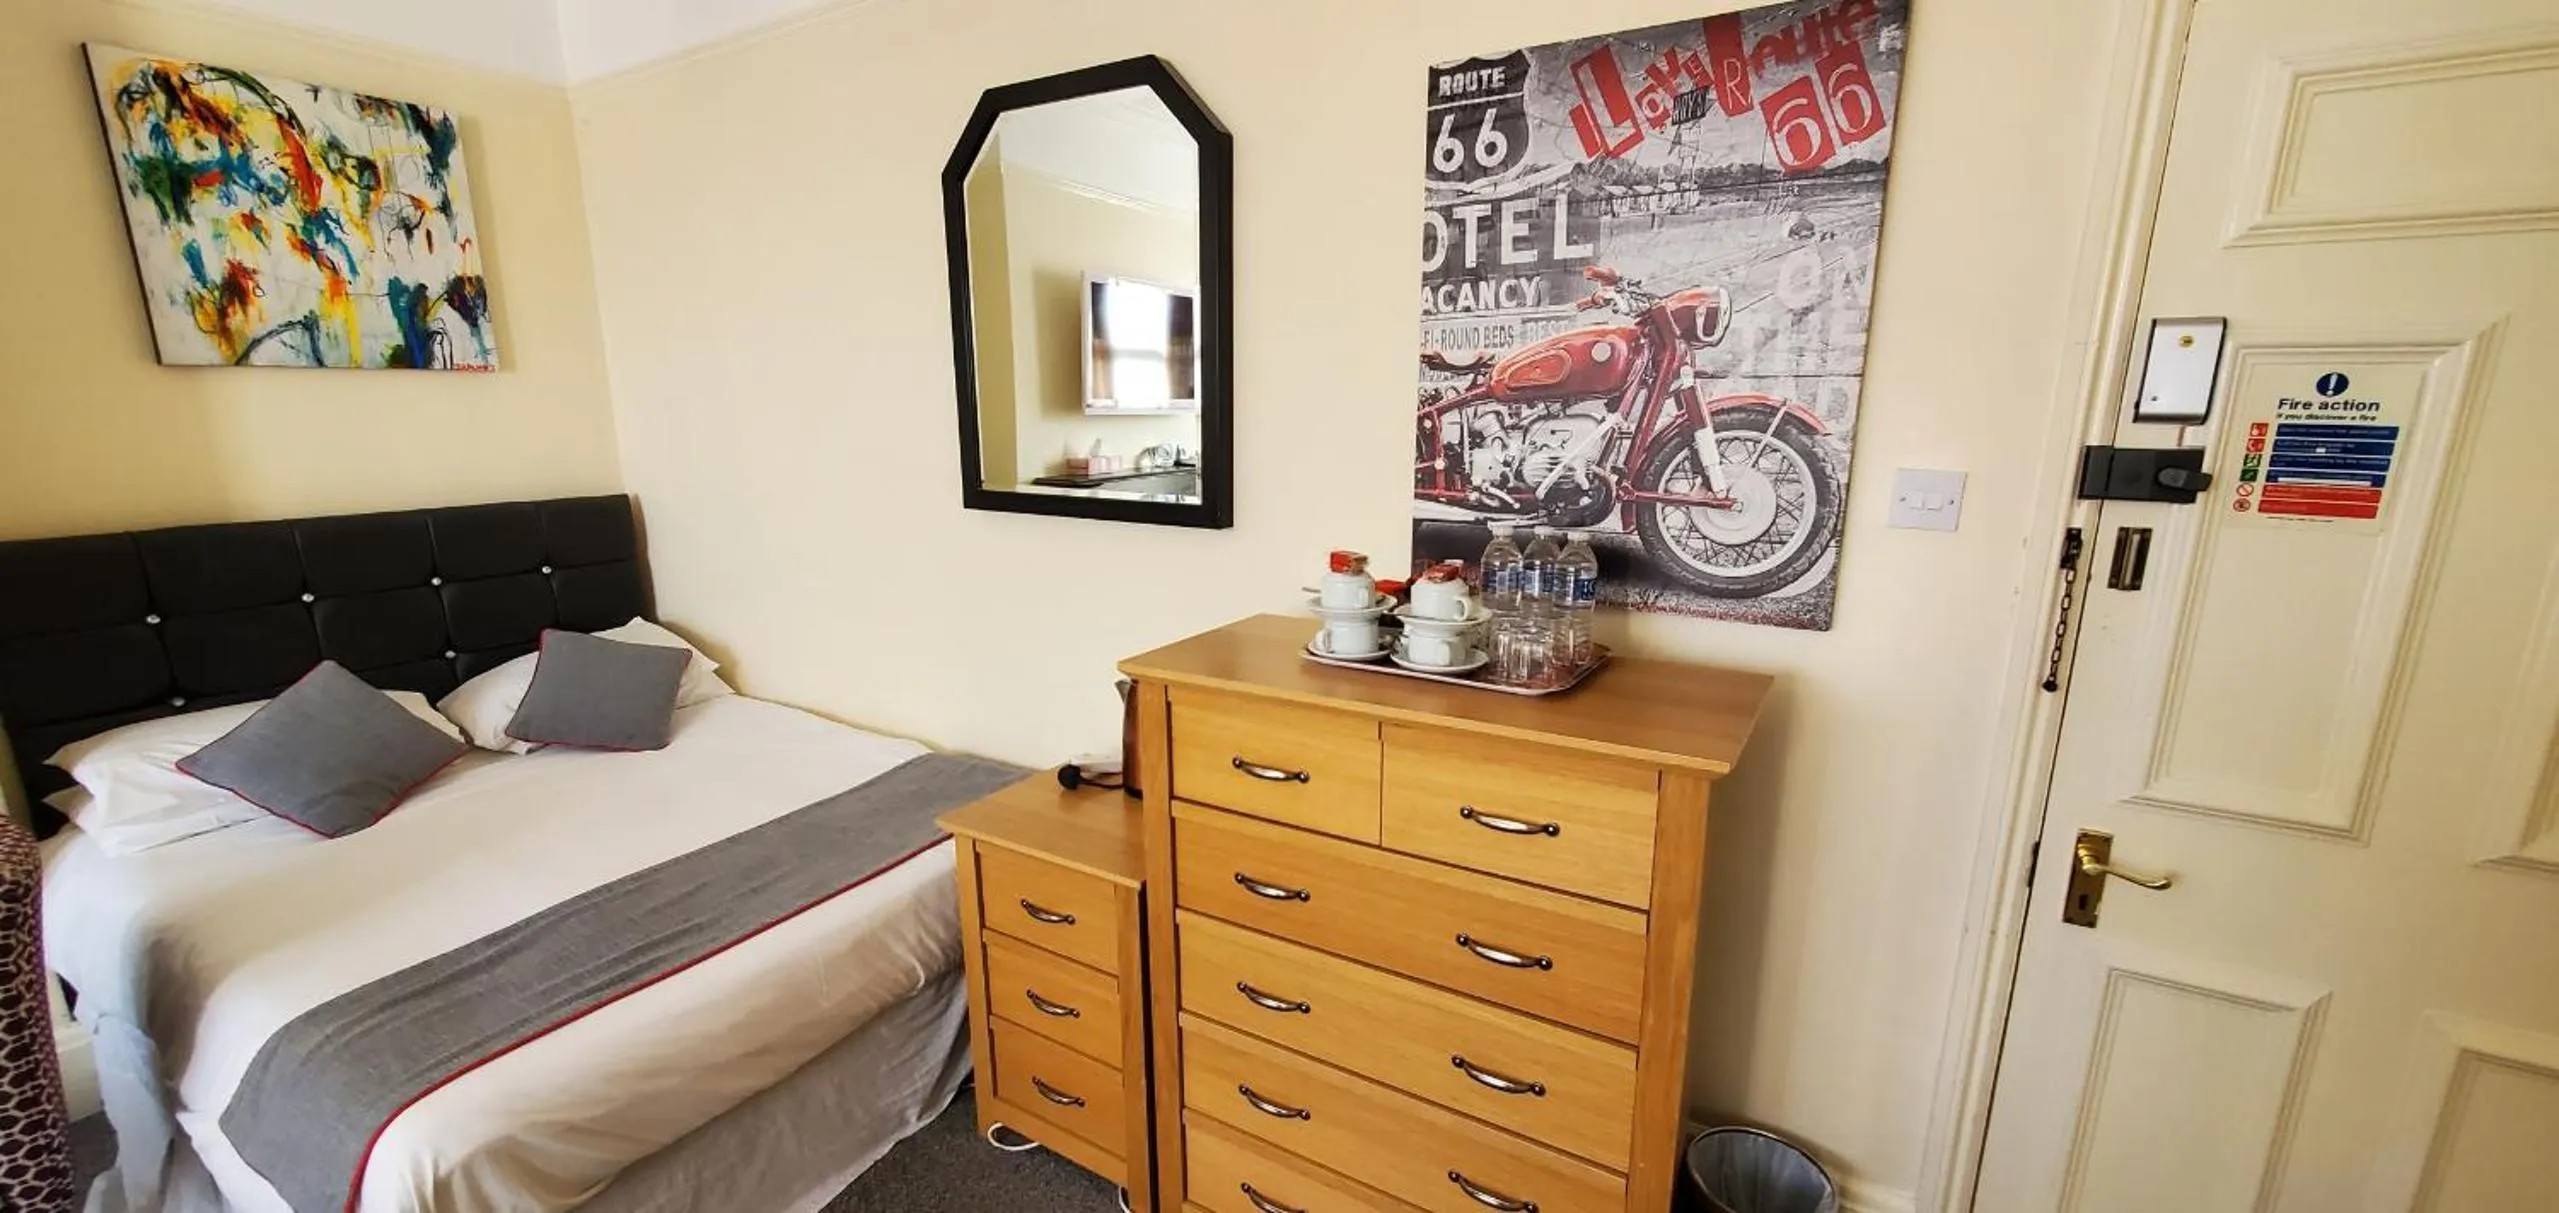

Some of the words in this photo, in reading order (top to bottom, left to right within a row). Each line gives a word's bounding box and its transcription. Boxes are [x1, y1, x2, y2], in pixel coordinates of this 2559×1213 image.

[1438, 66, 1506, 97] ROUTE
[1772, 62, 1873, 168] 66
[1433, 107, 1508, 173] 66
[1484, 324, 1515, 349] BEDS
[2277, 397, 2313, 411] Fire
[2318, 399, 2380, 412] action
